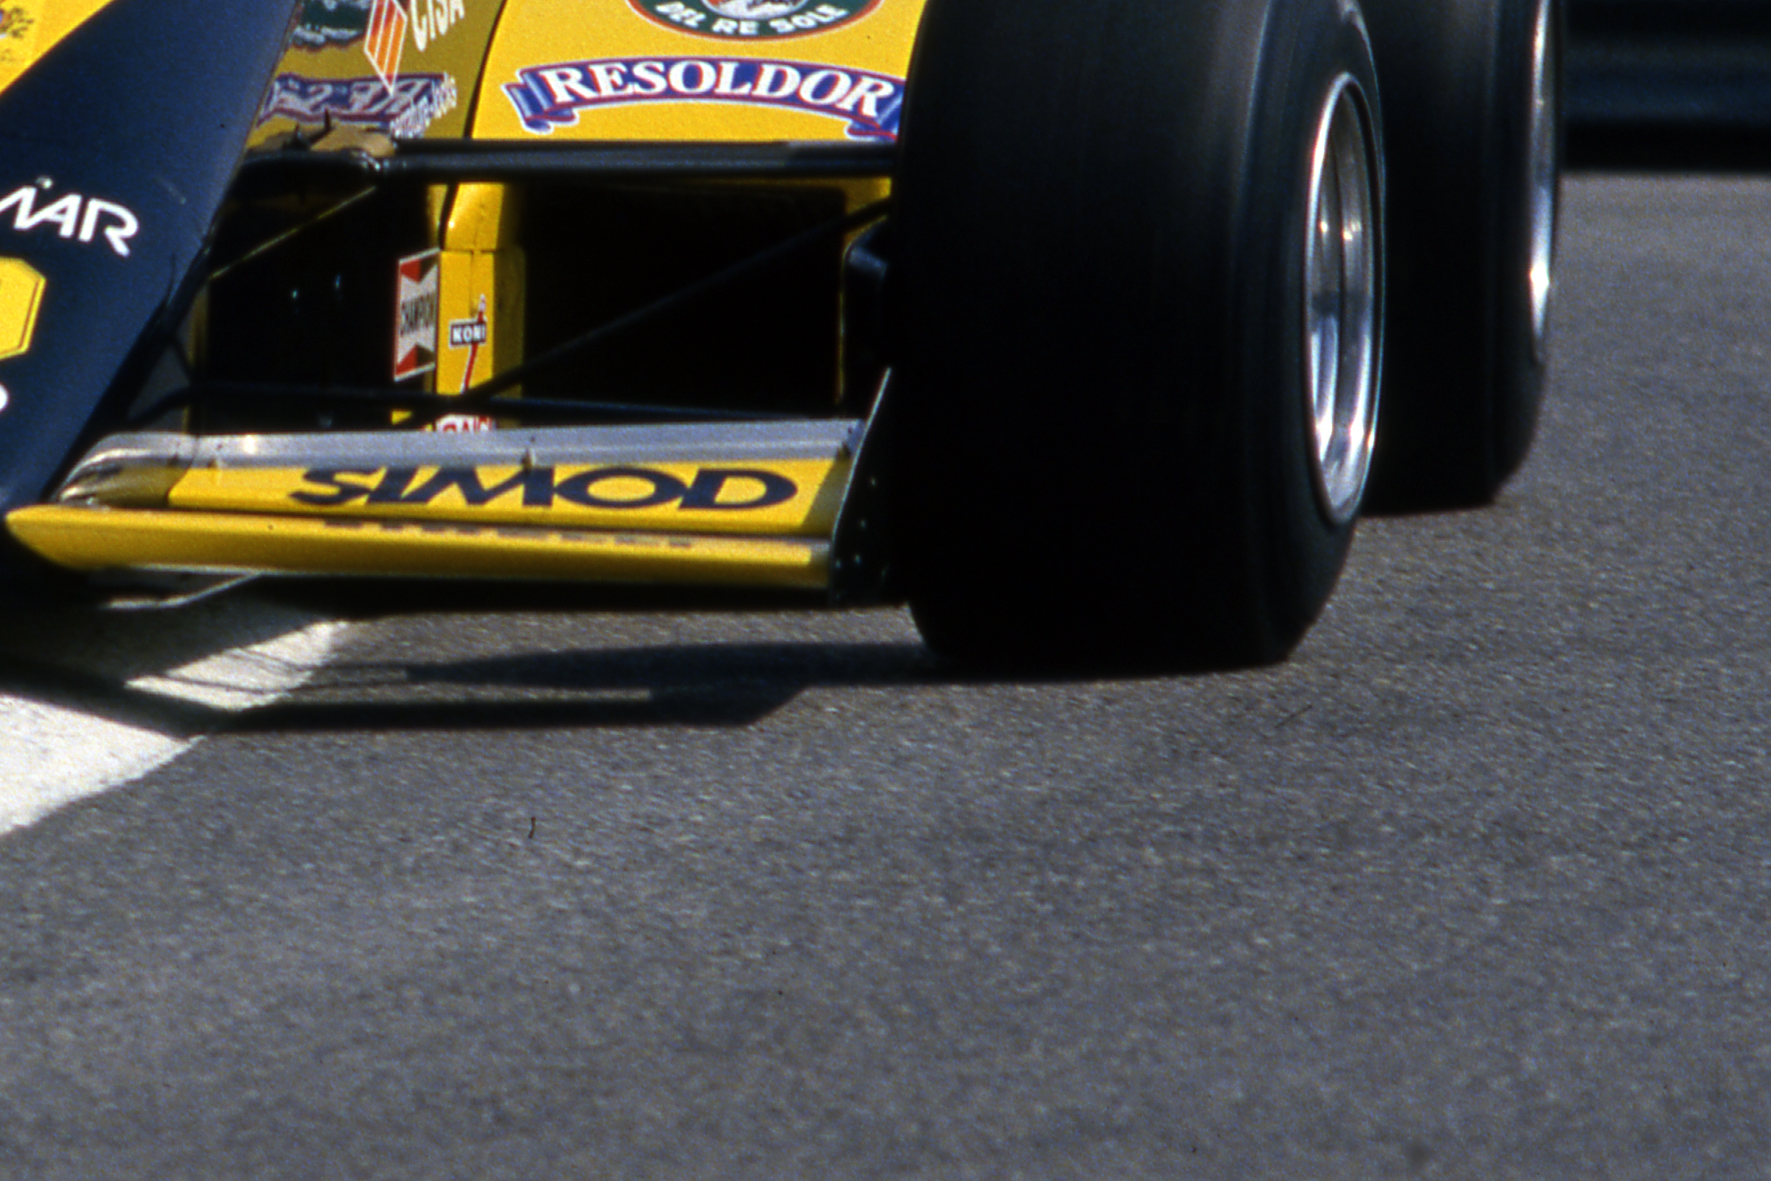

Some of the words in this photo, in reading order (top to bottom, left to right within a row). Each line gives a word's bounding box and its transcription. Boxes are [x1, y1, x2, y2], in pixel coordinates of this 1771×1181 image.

[655, 0, 707, 28] DEL
[712, 18, 759, 36] RE
[769, 3, 850, 35] SOLE
[538, 59, 895, 118] RESOLDOR
[451, 323, 486, 344] KONI
[289, 464, 800, 511] SIMOD
